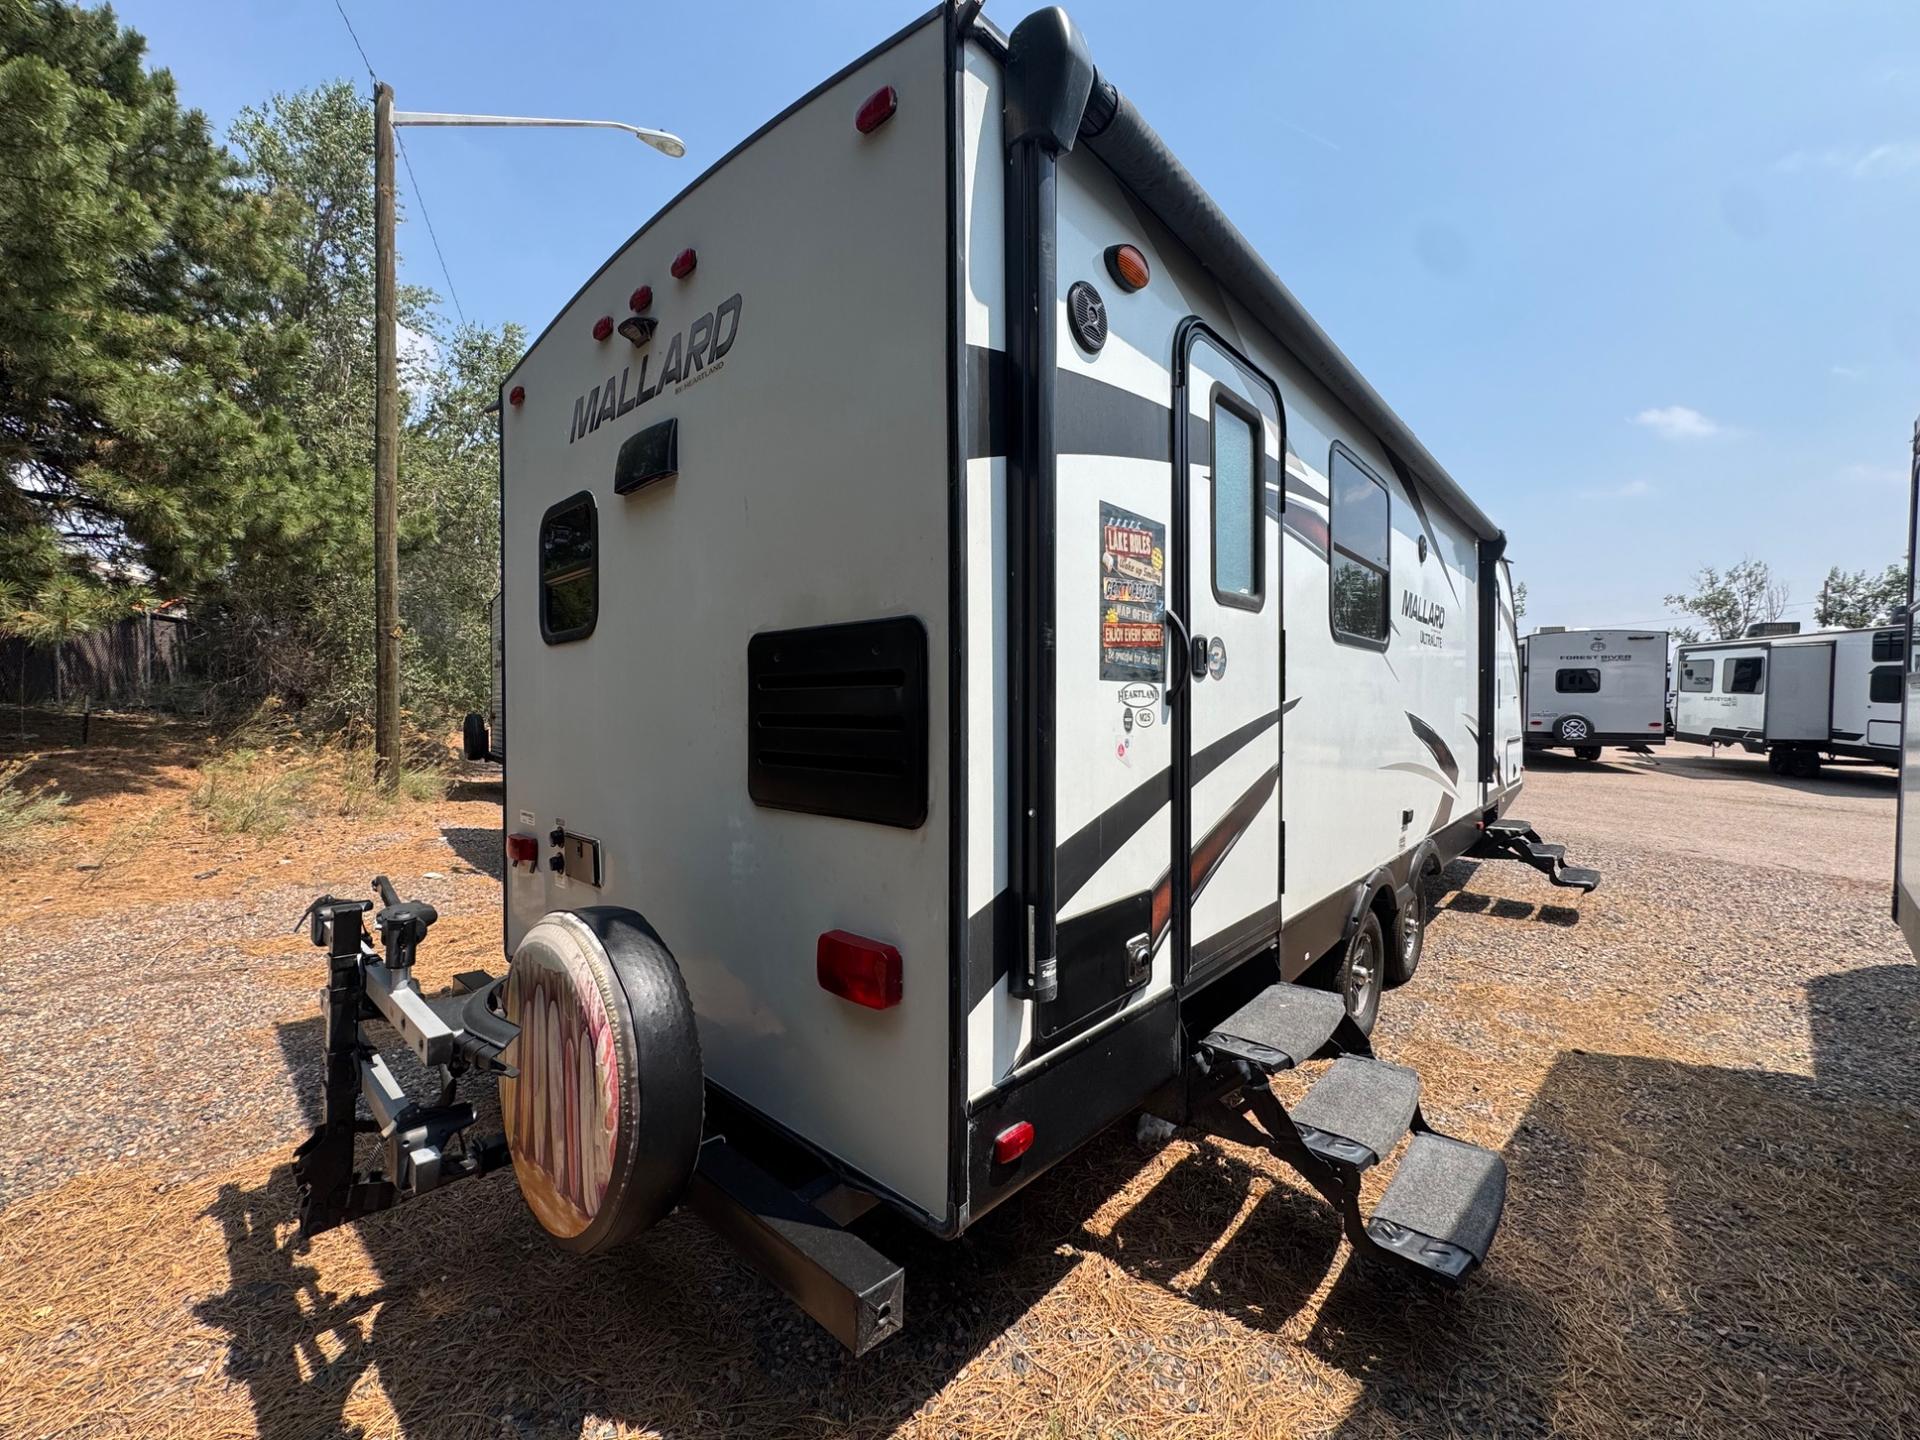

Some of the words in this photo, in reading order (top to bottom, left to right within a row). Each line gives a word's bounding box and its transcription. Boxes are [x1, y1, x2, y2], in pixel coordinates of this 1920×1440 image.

[569, 292, 743, 444] MALLARD
[683, 361, 725, 389] HEARTLAND
[1108, 530, 1129, 552] LAKE
[1129, 533, 1151, 555] RULES
[1119, 558, 1134, 572] Wake
[1135, 567, 1143, 576] up
[1106, 580, 1121, 596] GET
[1116, 604, 1131, 618] NAP
[1132, 608, 1153, 622] OFTEN
[1401, 589, 1445, 629] MALLARD
[1105, 627, 1124, 642] ENJOY
[1125, 627, 1142, 642] EVERY
[1142, 628, 1161, 642] SUNSET
[1117, 689, 1160, 703] HEARTLAND
